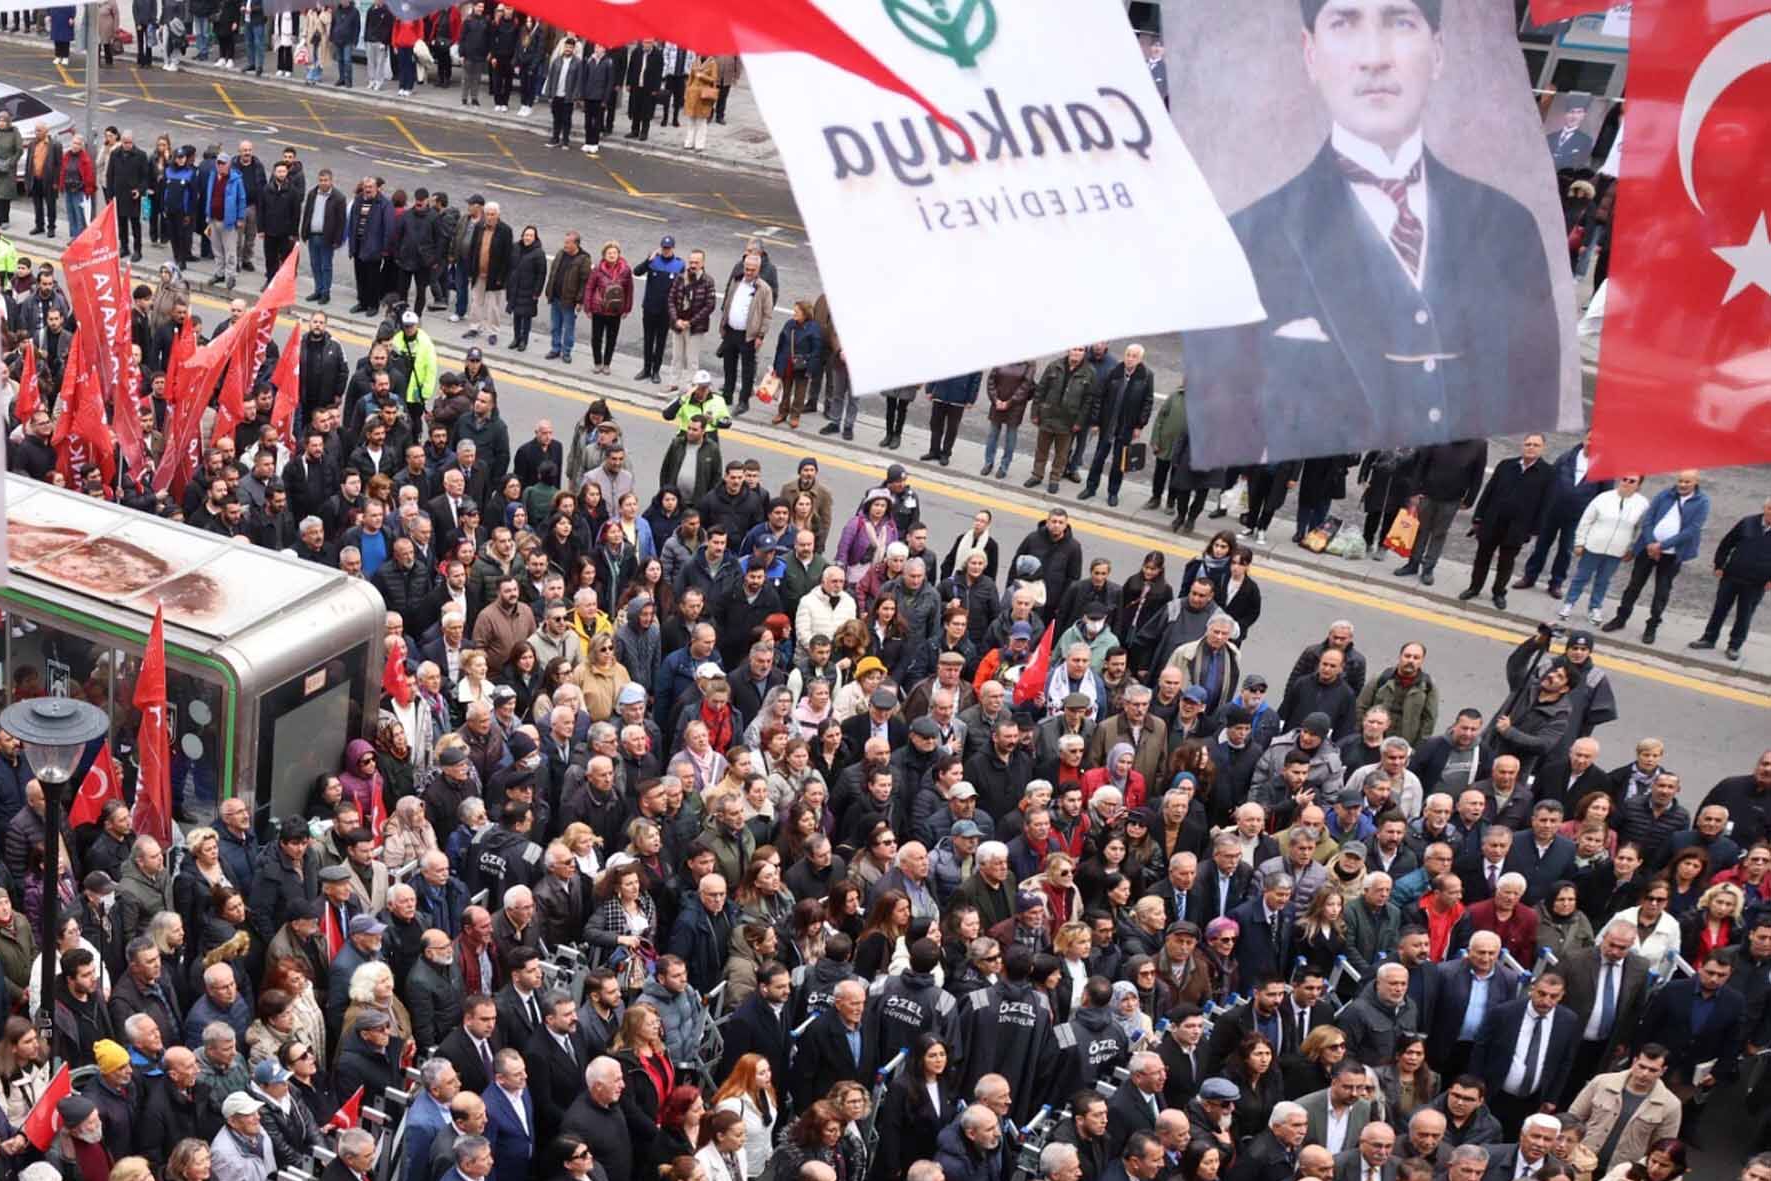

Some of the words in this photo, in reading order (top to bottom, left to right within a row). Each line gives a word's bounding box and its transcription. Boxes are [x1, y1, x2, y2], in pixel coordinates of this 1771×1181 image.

[480, 852, 507, 872] ÖZEL
[887, 995, 924, 1018] ÖZEL
[999, 1001, 1036, 1018] ÖZEL
[1089, 1040, 1120, 1055] ÖZEL
